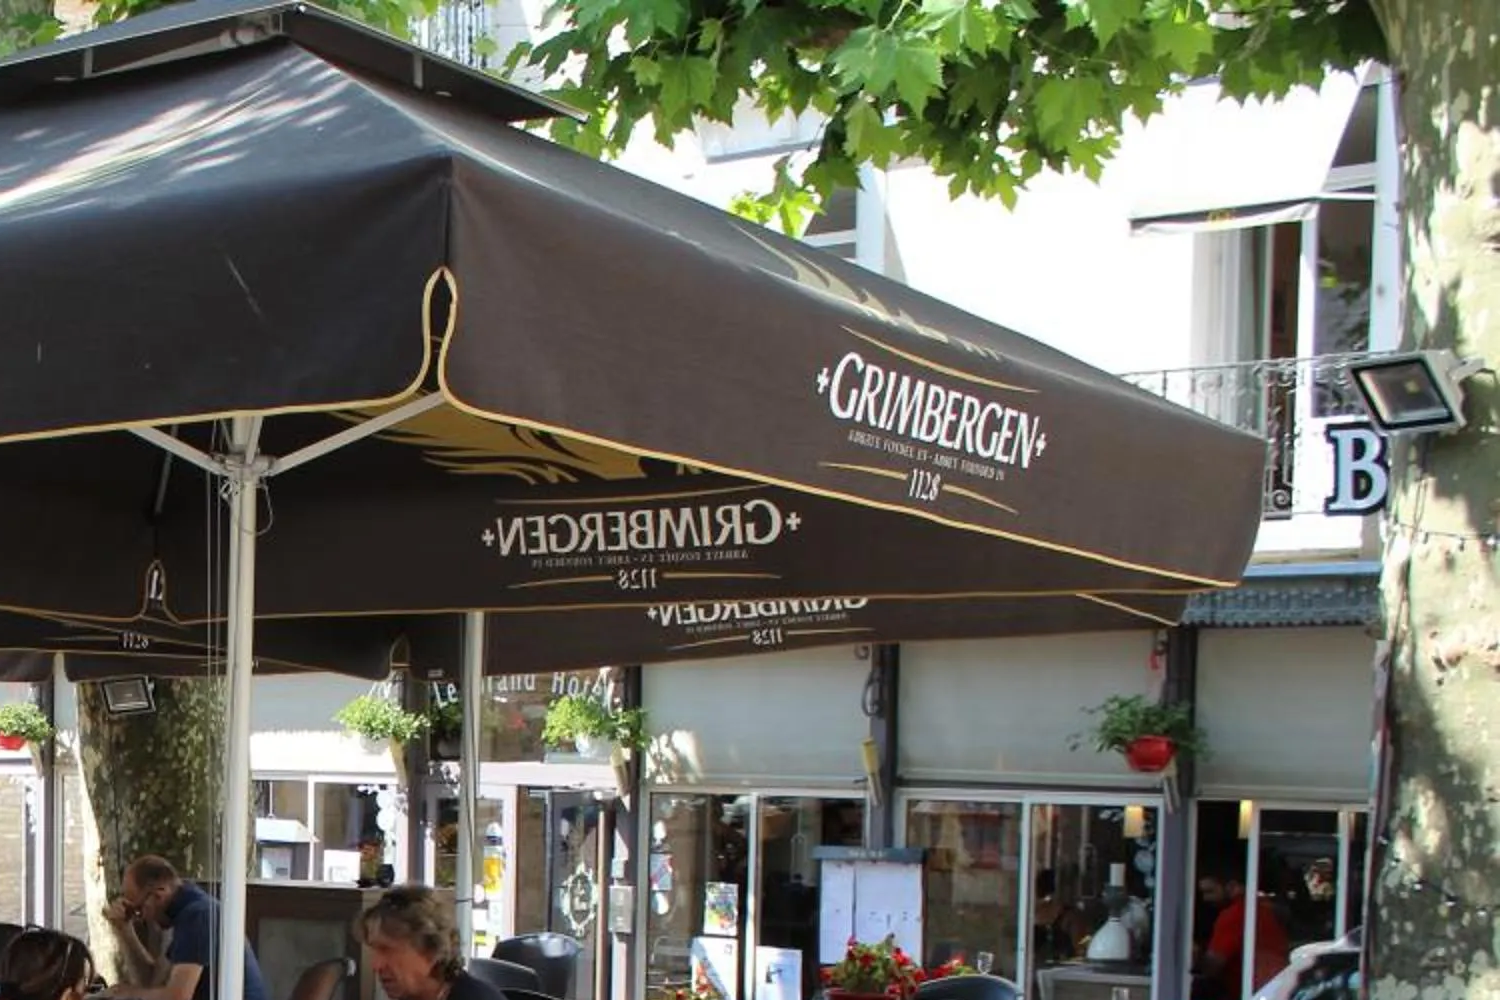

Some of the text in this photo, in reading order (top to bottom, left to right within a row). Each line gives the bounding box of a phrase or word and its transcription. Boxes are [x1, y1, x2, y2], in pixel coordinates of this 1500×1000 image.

[829, 351, 1040, 469] GRIMBERGEN
[909, 468, 941, 500] 1128
[432, 681, 459, 709] Le
[481, 673, 536, 698] rand
